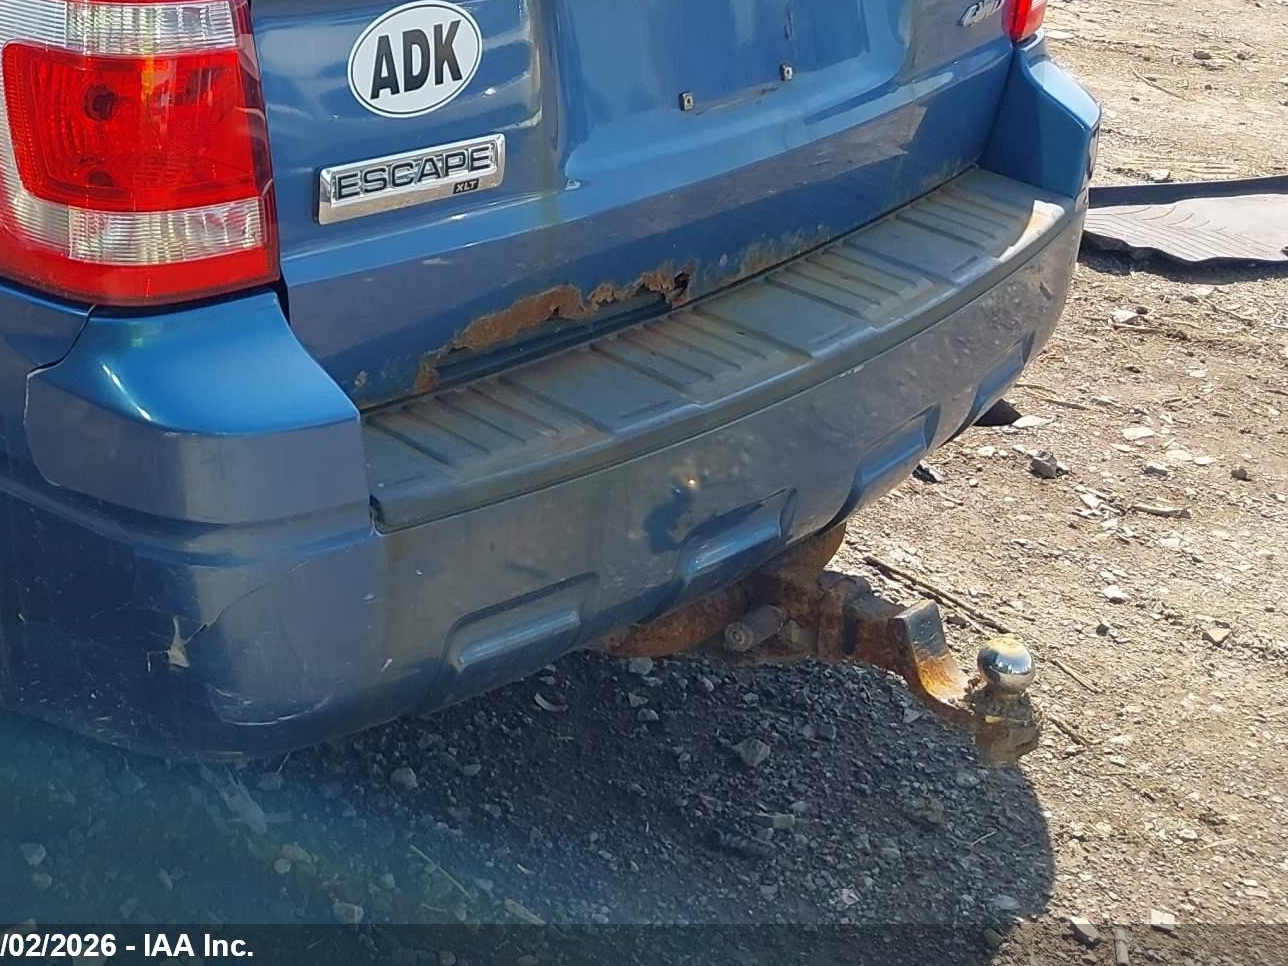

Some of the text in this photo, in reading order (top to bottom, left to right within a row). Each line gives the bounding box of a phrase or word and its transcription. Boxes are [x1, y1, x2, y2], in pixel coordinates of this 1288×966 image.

[370, 20, 463, 100] ADK
[337, 146, 491, 200] ESCAPE
[455, 180, 478, 193] XLT
